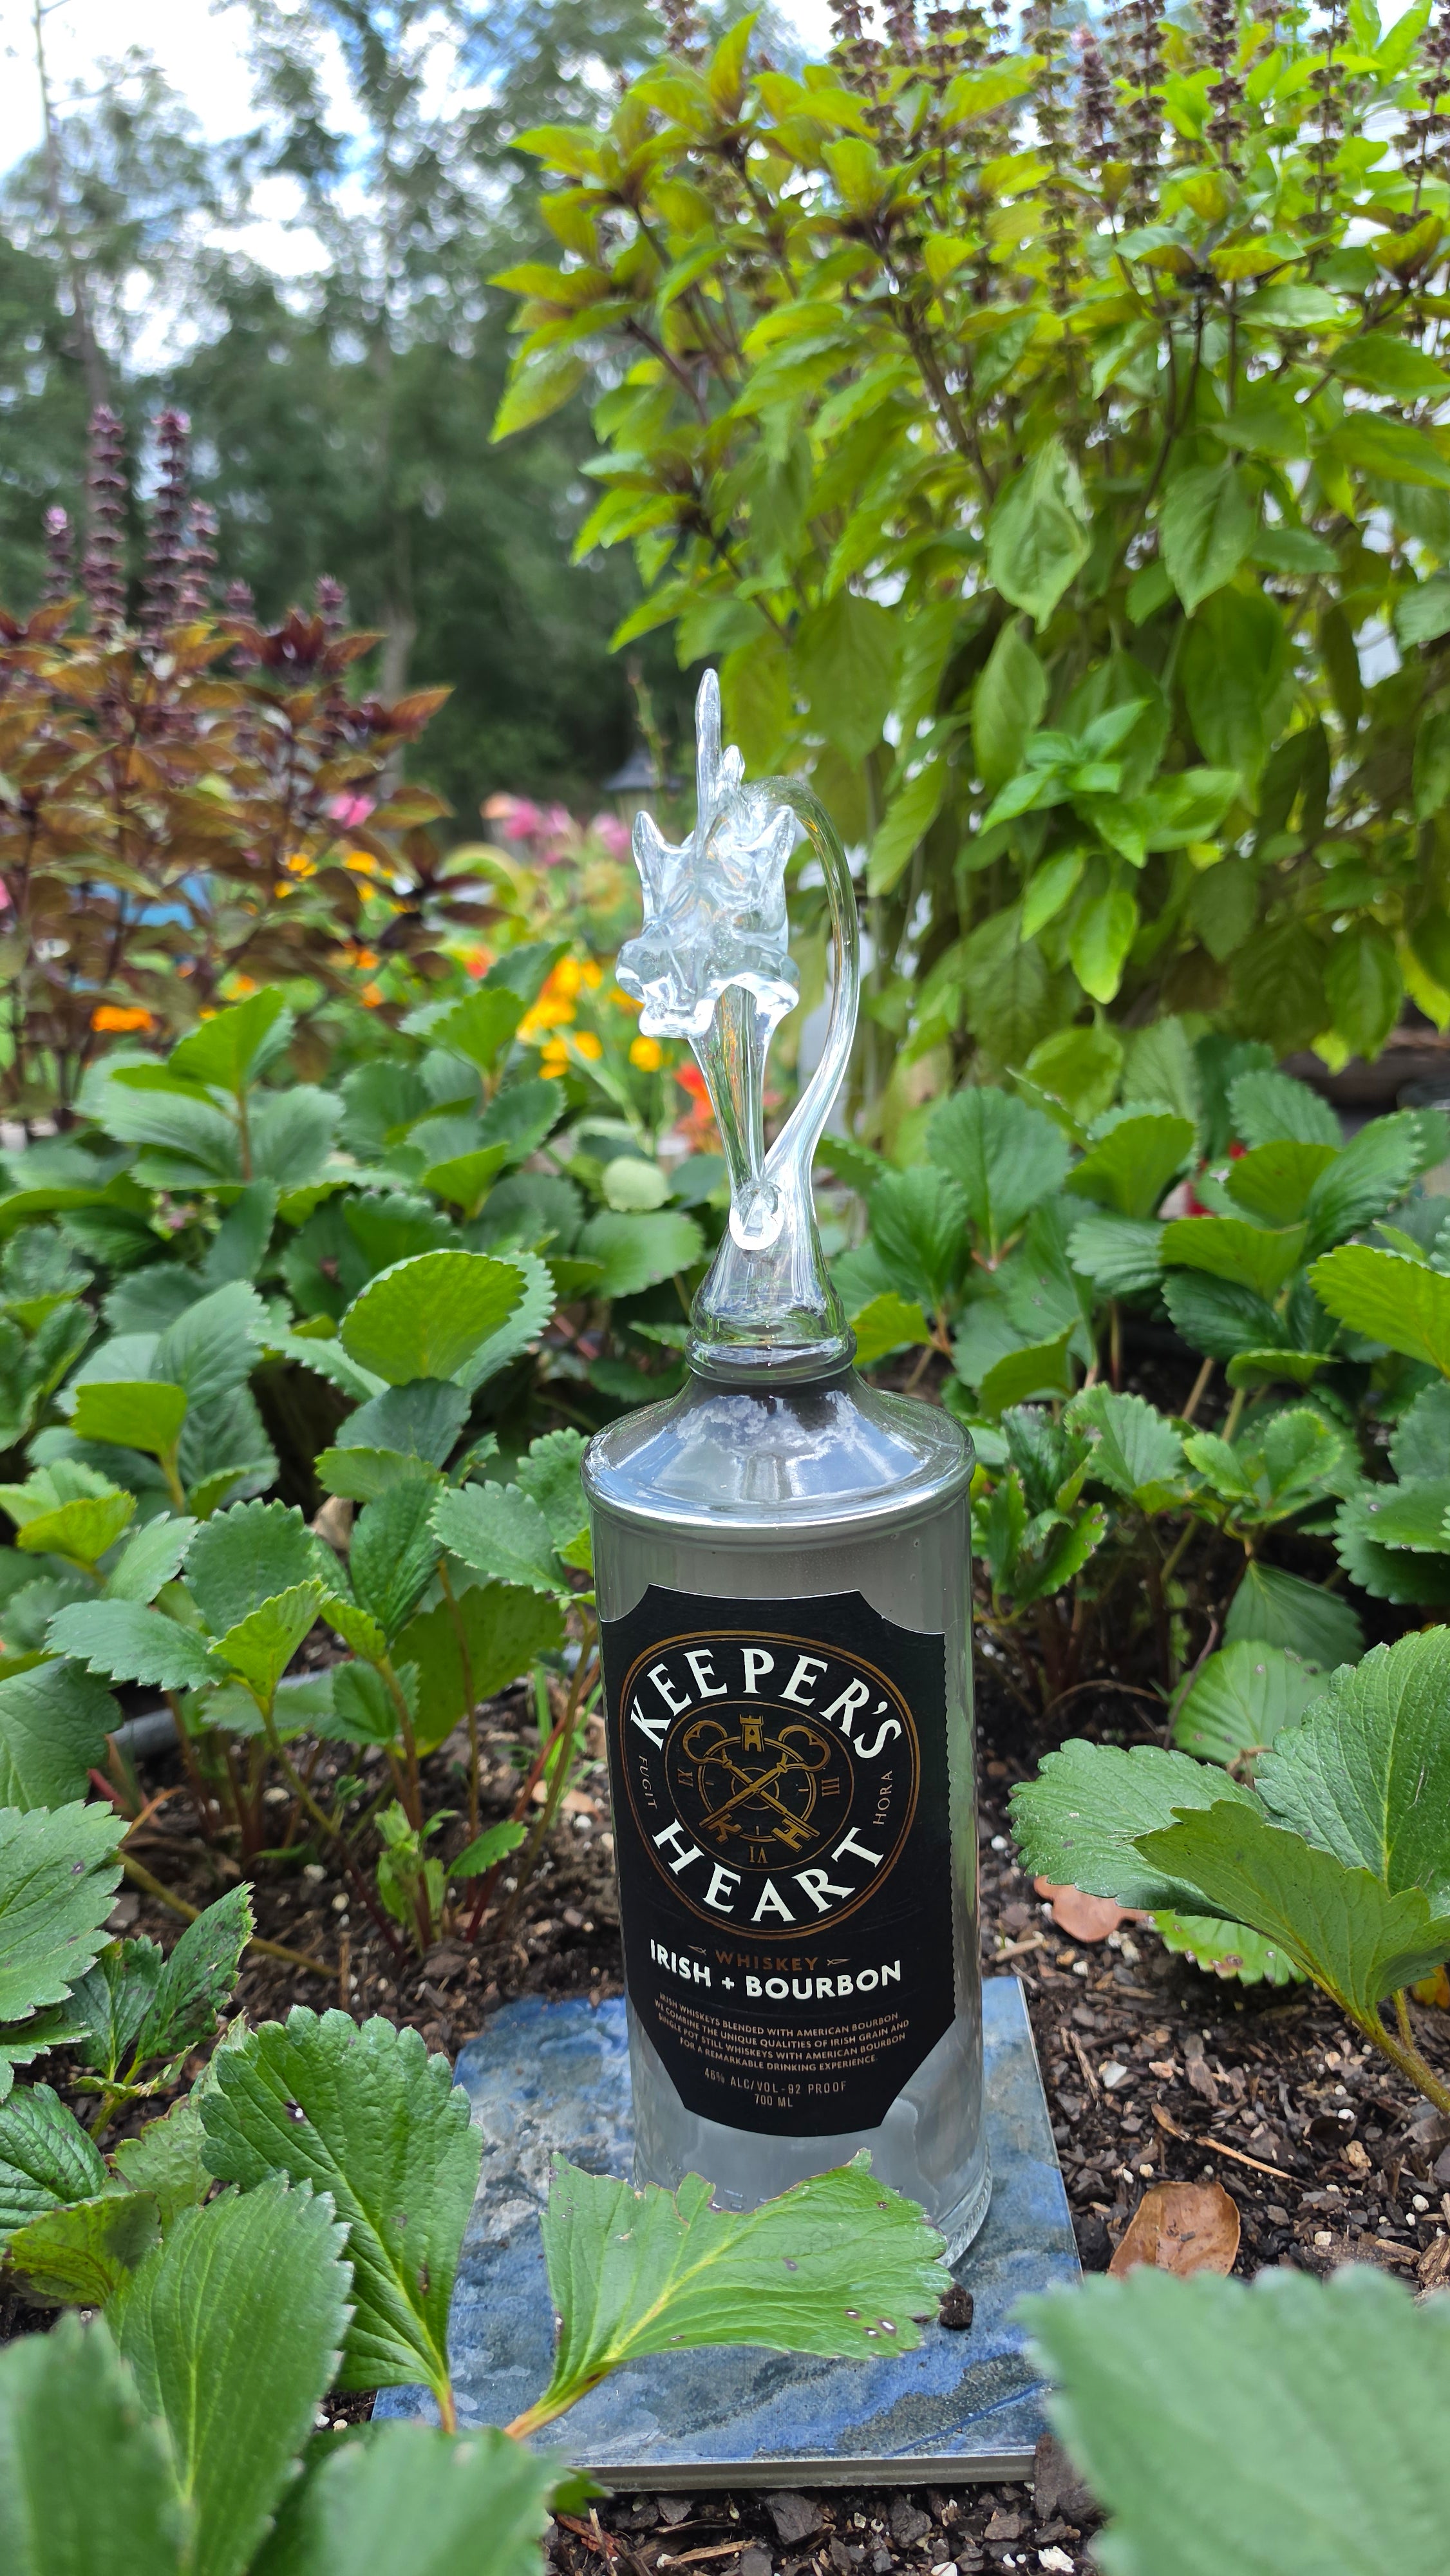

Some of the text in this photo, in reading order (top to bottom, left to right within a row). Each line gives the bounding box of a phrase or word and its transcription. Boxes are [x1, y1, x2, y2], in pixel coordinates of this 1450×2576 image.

[630, 1648, 902, 1759] KEEPER'S
[639, 1756, 657, 1808] FUGIT
[872, 1770, 893, 1824] HORA
[653, 1819, 884, 1922] HEART
[650, 1939, 901, 2000] IRISH + BOURBON
[715, 1949, 818, 1971] WHISKEY
[654, 1999, 909, 2049] WE COMBINE THE UNIQUE QUALITIES OF IRISH GRAIN AND
[658, 2012, 905, 2060] SINGLE POT STILL WHISKEYS WITH AMERICAN BOURBON
[660, 1992, 677, 2009] IRISH
[679, 2003, 720, 2026] WHISKEYS
[722, 2020, 764, 2034] BLENDED
[767, 2028, 793, 2037] WITH
[796, 2025, 849, 2037] AMERICAN
[680, 2037, 695, 2050] FOR
[697, 2045, 702, 2054] A
[705, 2048, 764, 2069] REMARKABLE
[767, 2062, 816, 2072] DRINKING
[704, 2067, 725, 2083] 46%
[808, 2080, 847, 2094] PROOF
[754, 2094, 793, 2107] 700 ML
